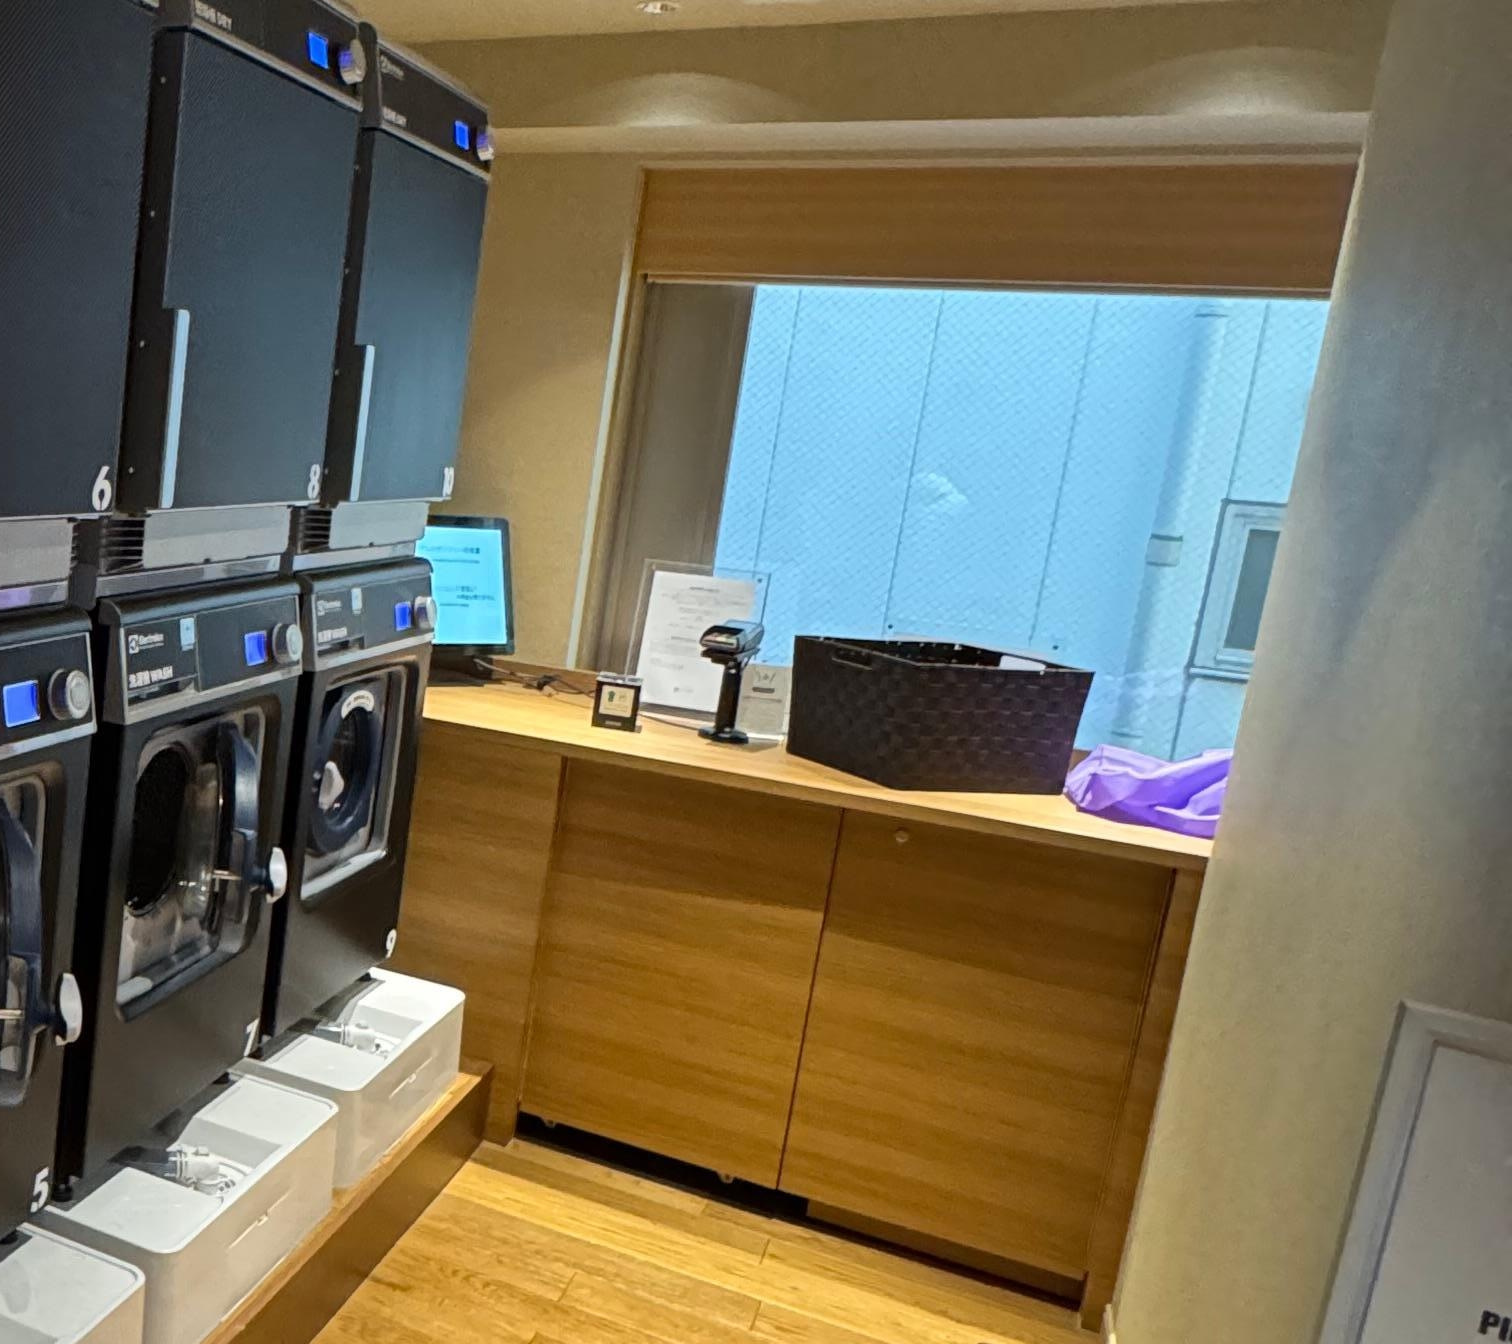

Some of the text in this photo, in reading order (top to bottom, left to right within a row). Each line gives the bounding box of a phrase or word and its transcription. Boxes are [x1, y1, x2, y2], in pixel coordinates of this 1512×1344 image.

[91, 465, 112, 512] 6
[307, 463, 321, 500] 8
[386, 928, 397, 958] 9
[244, 1017, 260, 1057] 7
[30, 1165, 49, 1213] 5
[1477, 1309, 1512, 1344] PI
